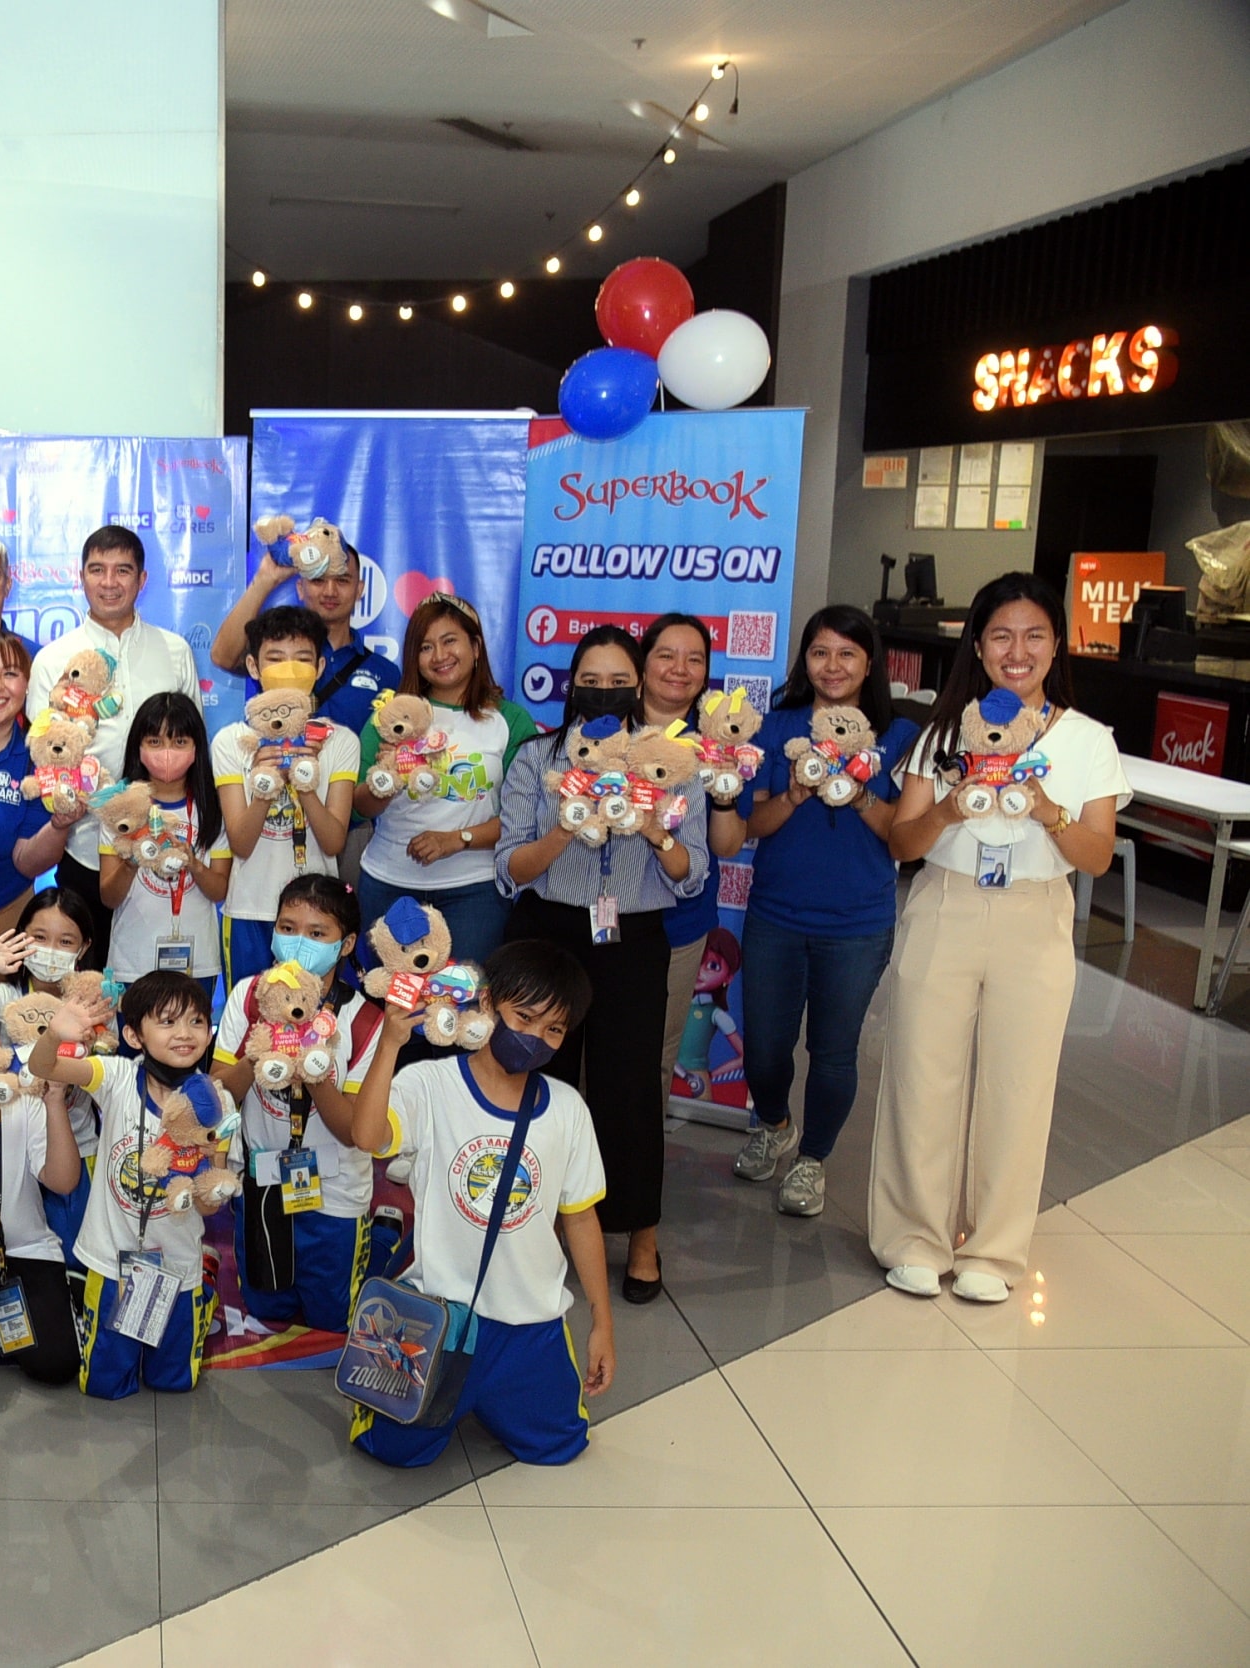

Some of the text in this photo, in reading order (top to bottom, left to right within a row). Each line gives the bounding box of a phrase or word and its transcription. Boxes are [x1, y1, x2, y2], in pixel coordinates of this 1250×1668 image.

[972, 325, 1163, 412] SNACKS
[110, 514, 150, 527] SMDC
[171, 522, 215, 534] CARES
[533, 545, 778, 580] FOLLOW US ON
[1080, 562, 1096, 570] NEW
[171, 571, 210, 585] SMDC
[1161, 721, 1215, 766] Snack
[393, 978, 416, 993] Bears
[397, 988, 413, 1002] Joy
[452, 1149, 469, 1175] CITY
[468, 1138, 483, 1153] OF
